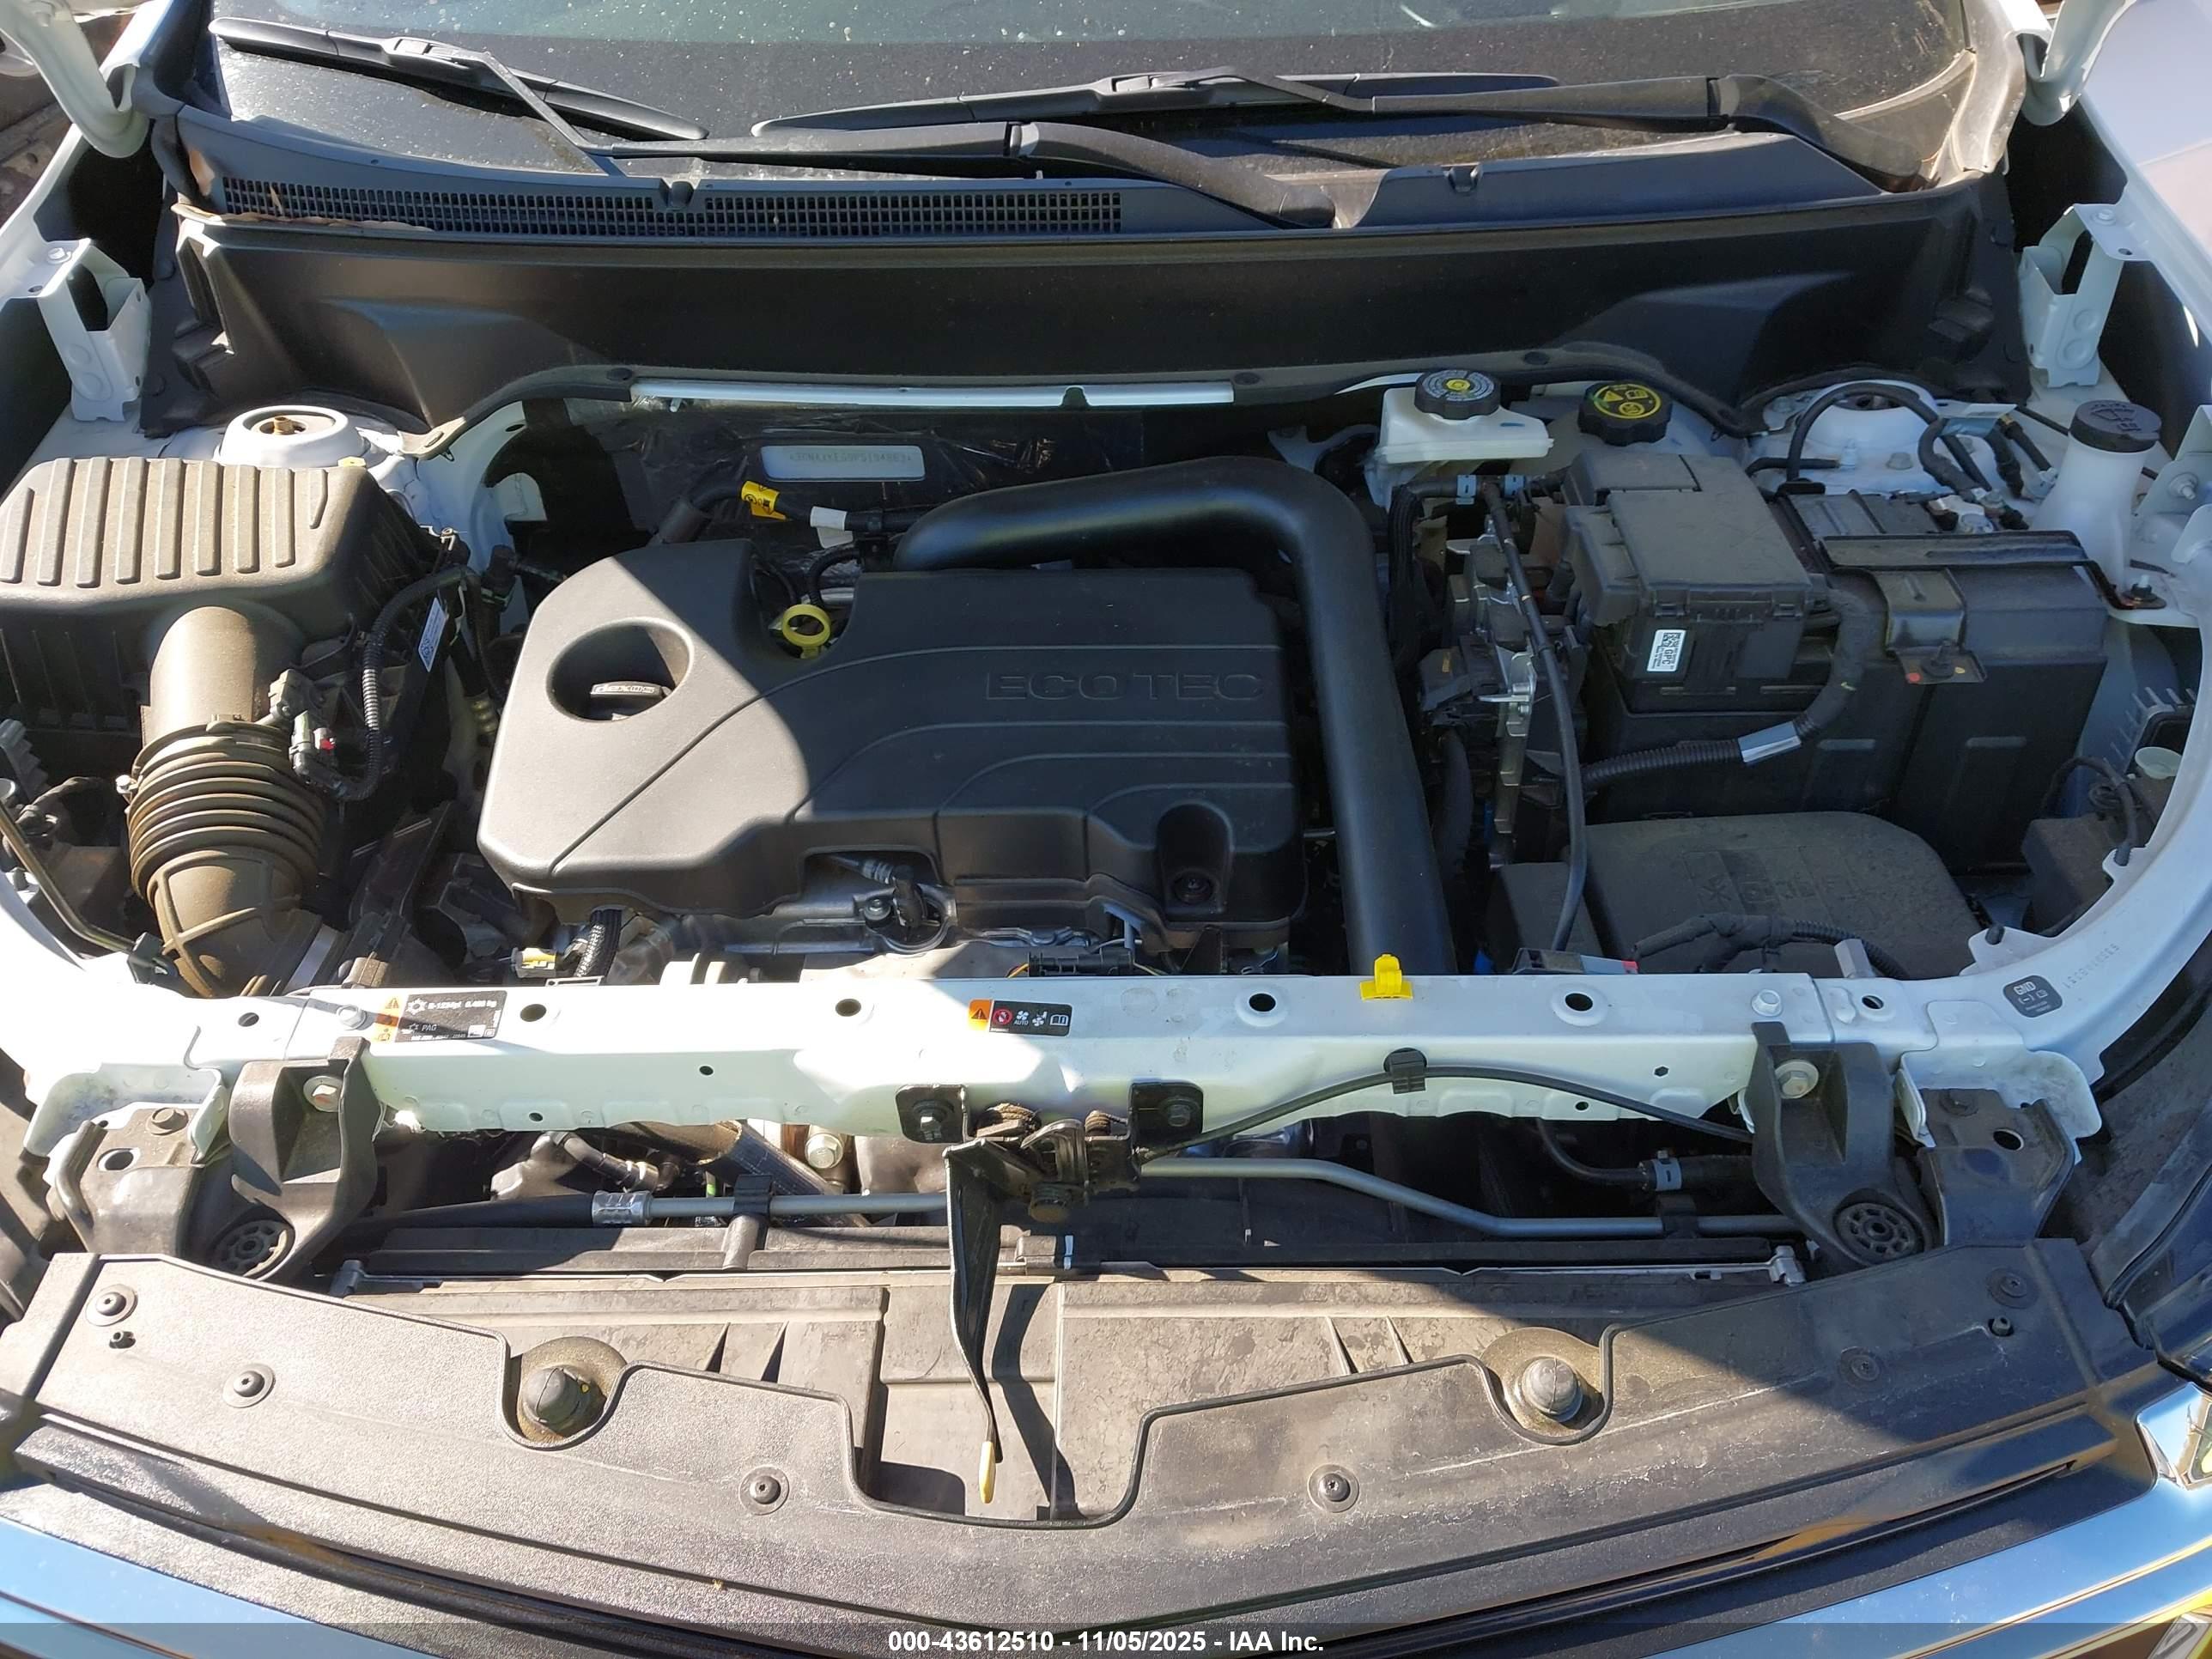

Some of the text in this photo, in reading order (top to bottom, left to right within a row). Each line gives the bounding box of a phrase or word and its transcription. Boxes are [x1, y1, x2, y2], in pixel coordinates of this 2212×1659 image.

[1662, 649, 1674, 665] GPC
[594, 684, 655, 693] dexos
[986, 672, 1265, 701] ECOTEC
[2013, 981, 2037, 995] GND
